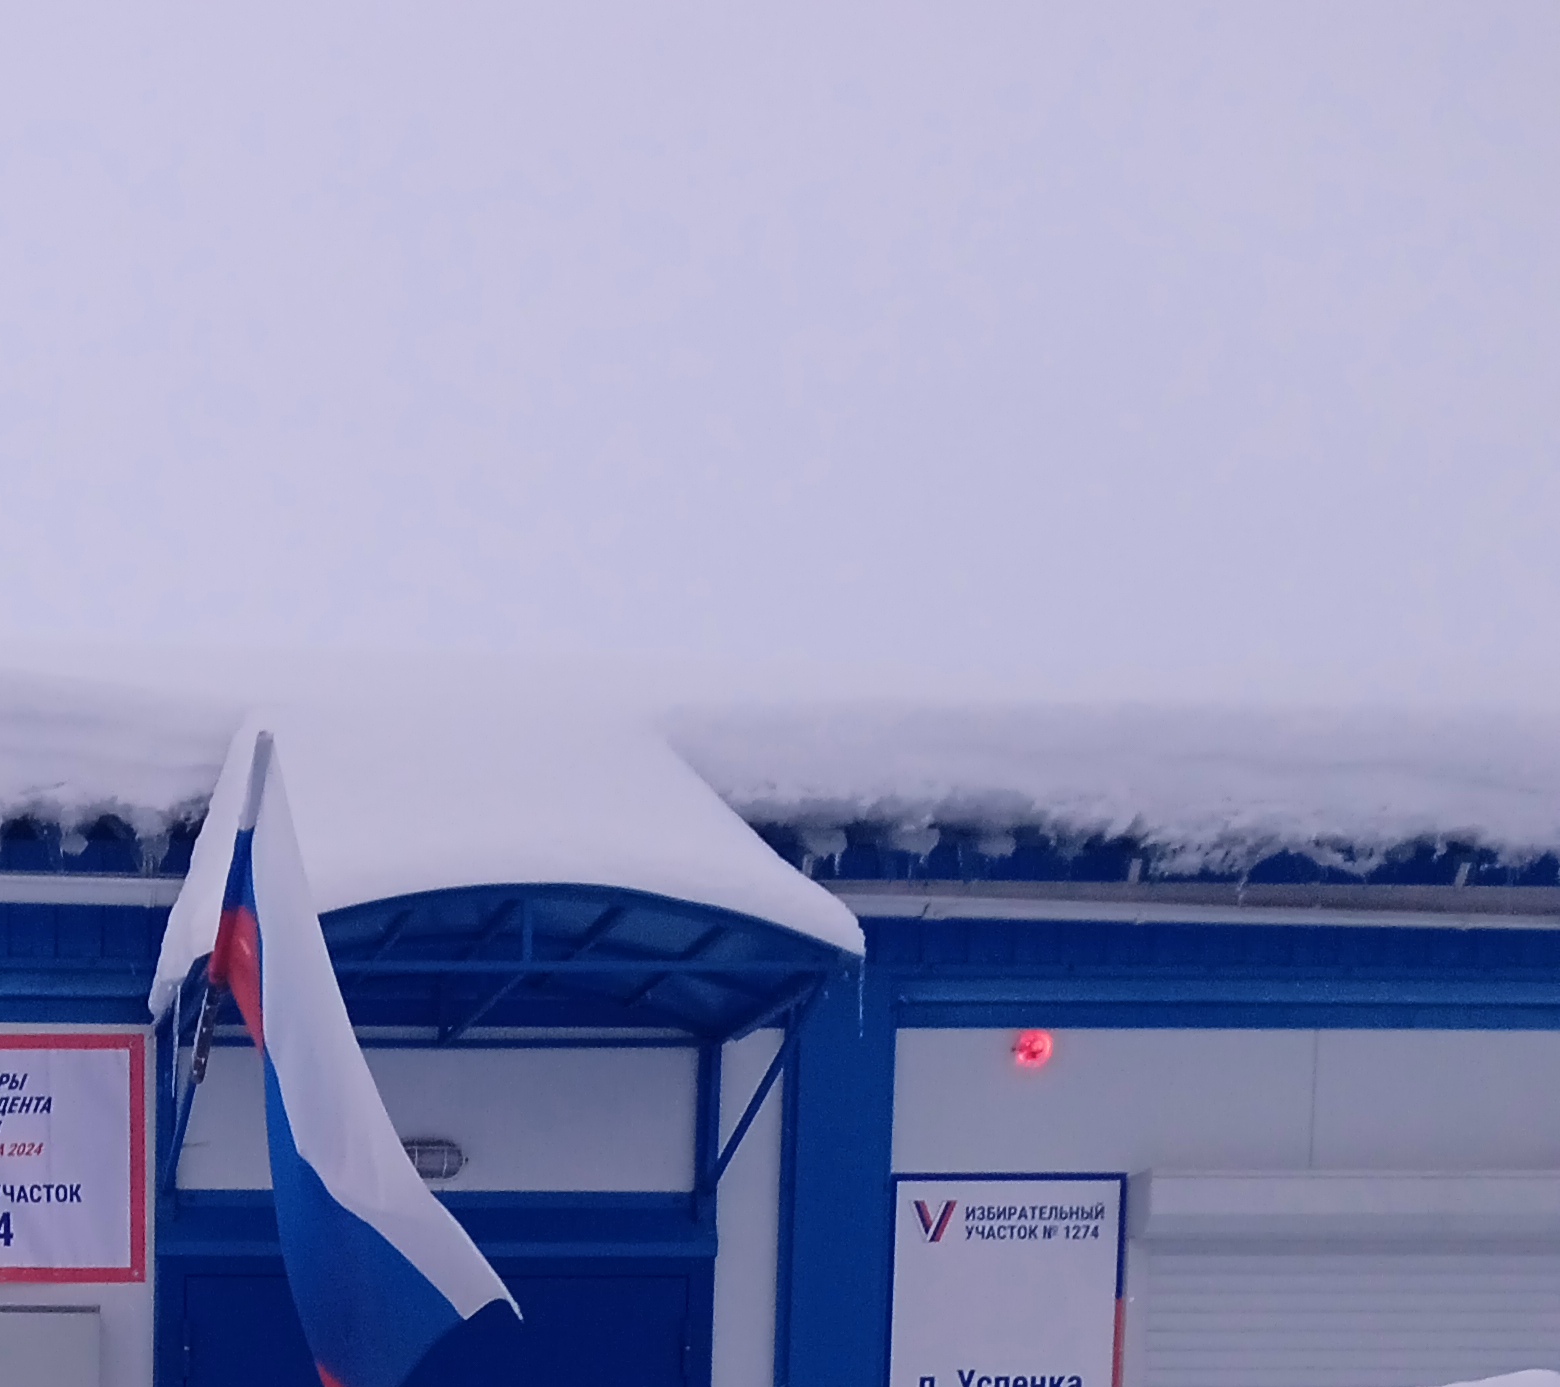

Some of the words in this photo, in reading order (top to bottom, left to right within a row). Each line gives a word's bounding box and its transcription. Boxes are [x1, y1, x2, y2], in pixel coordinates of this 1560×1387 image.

[7, 1142, 44, 1156] 2024
[964, 1202, 1106, 1222] ИЗБИРАТЕЛЬНЫЙ
[964, 1224, 1039, 1241] УЧАСТОК
[1063, 1224, 1100, 1241] 1274
